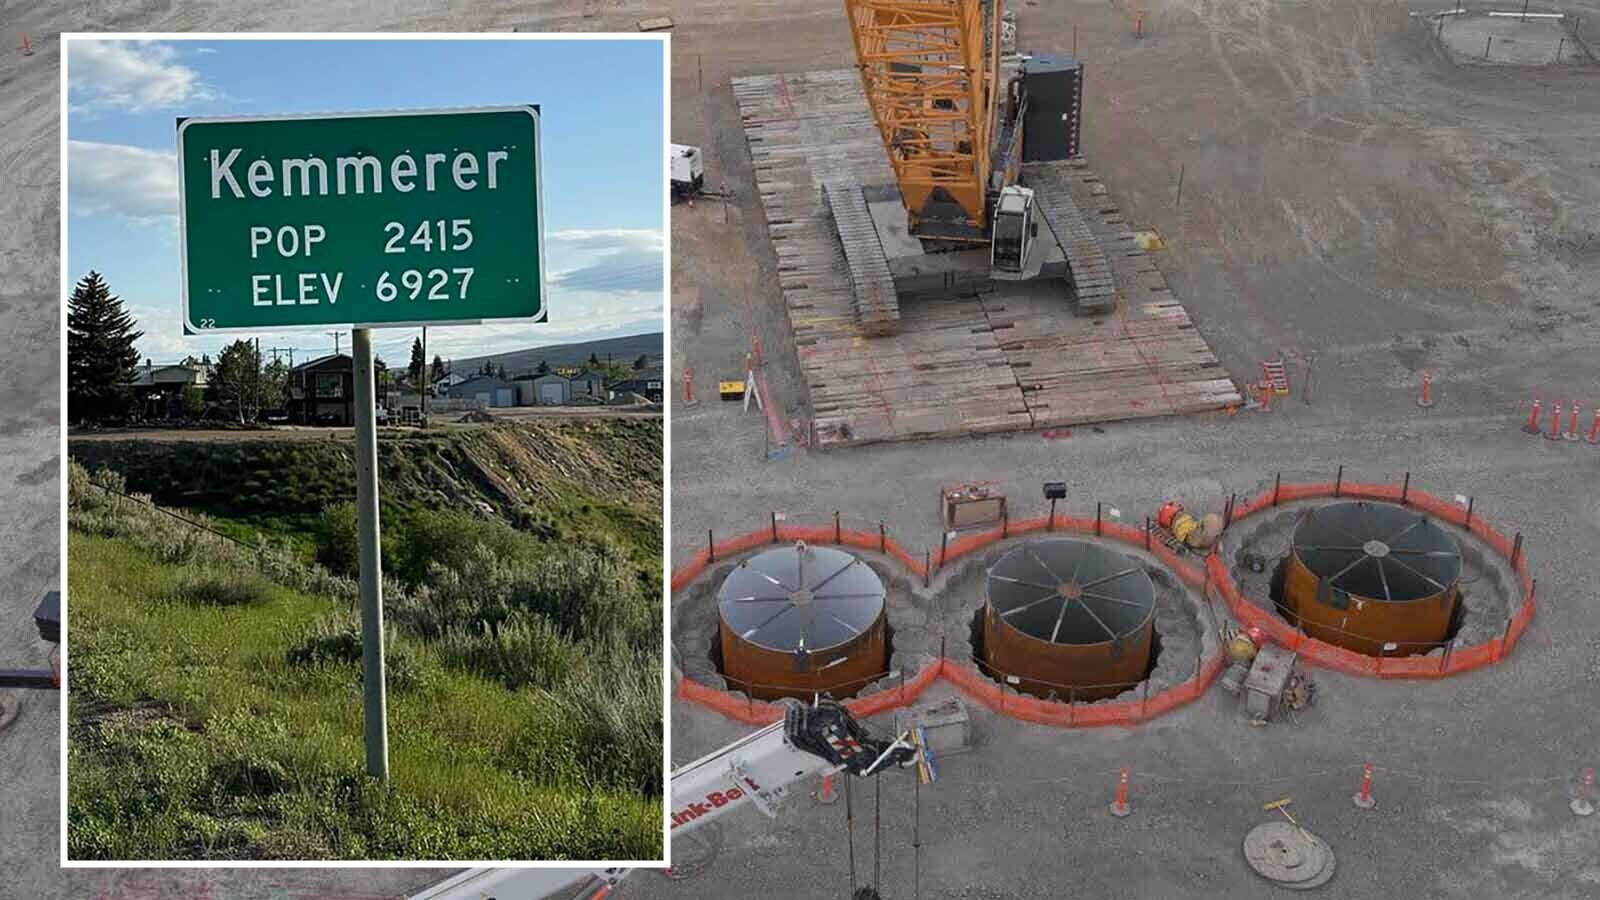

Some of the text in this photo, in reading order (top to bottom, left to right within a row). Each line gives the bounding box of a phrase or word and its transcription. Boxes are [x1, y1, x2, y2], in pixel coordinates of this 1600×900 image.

[210, 148, 508, 198] Kemmerer
[250, 219, 474, 258] POP 2415
[251, 267, 475, 306] ELEV 6927
[200, 318, 216, 329] 22
